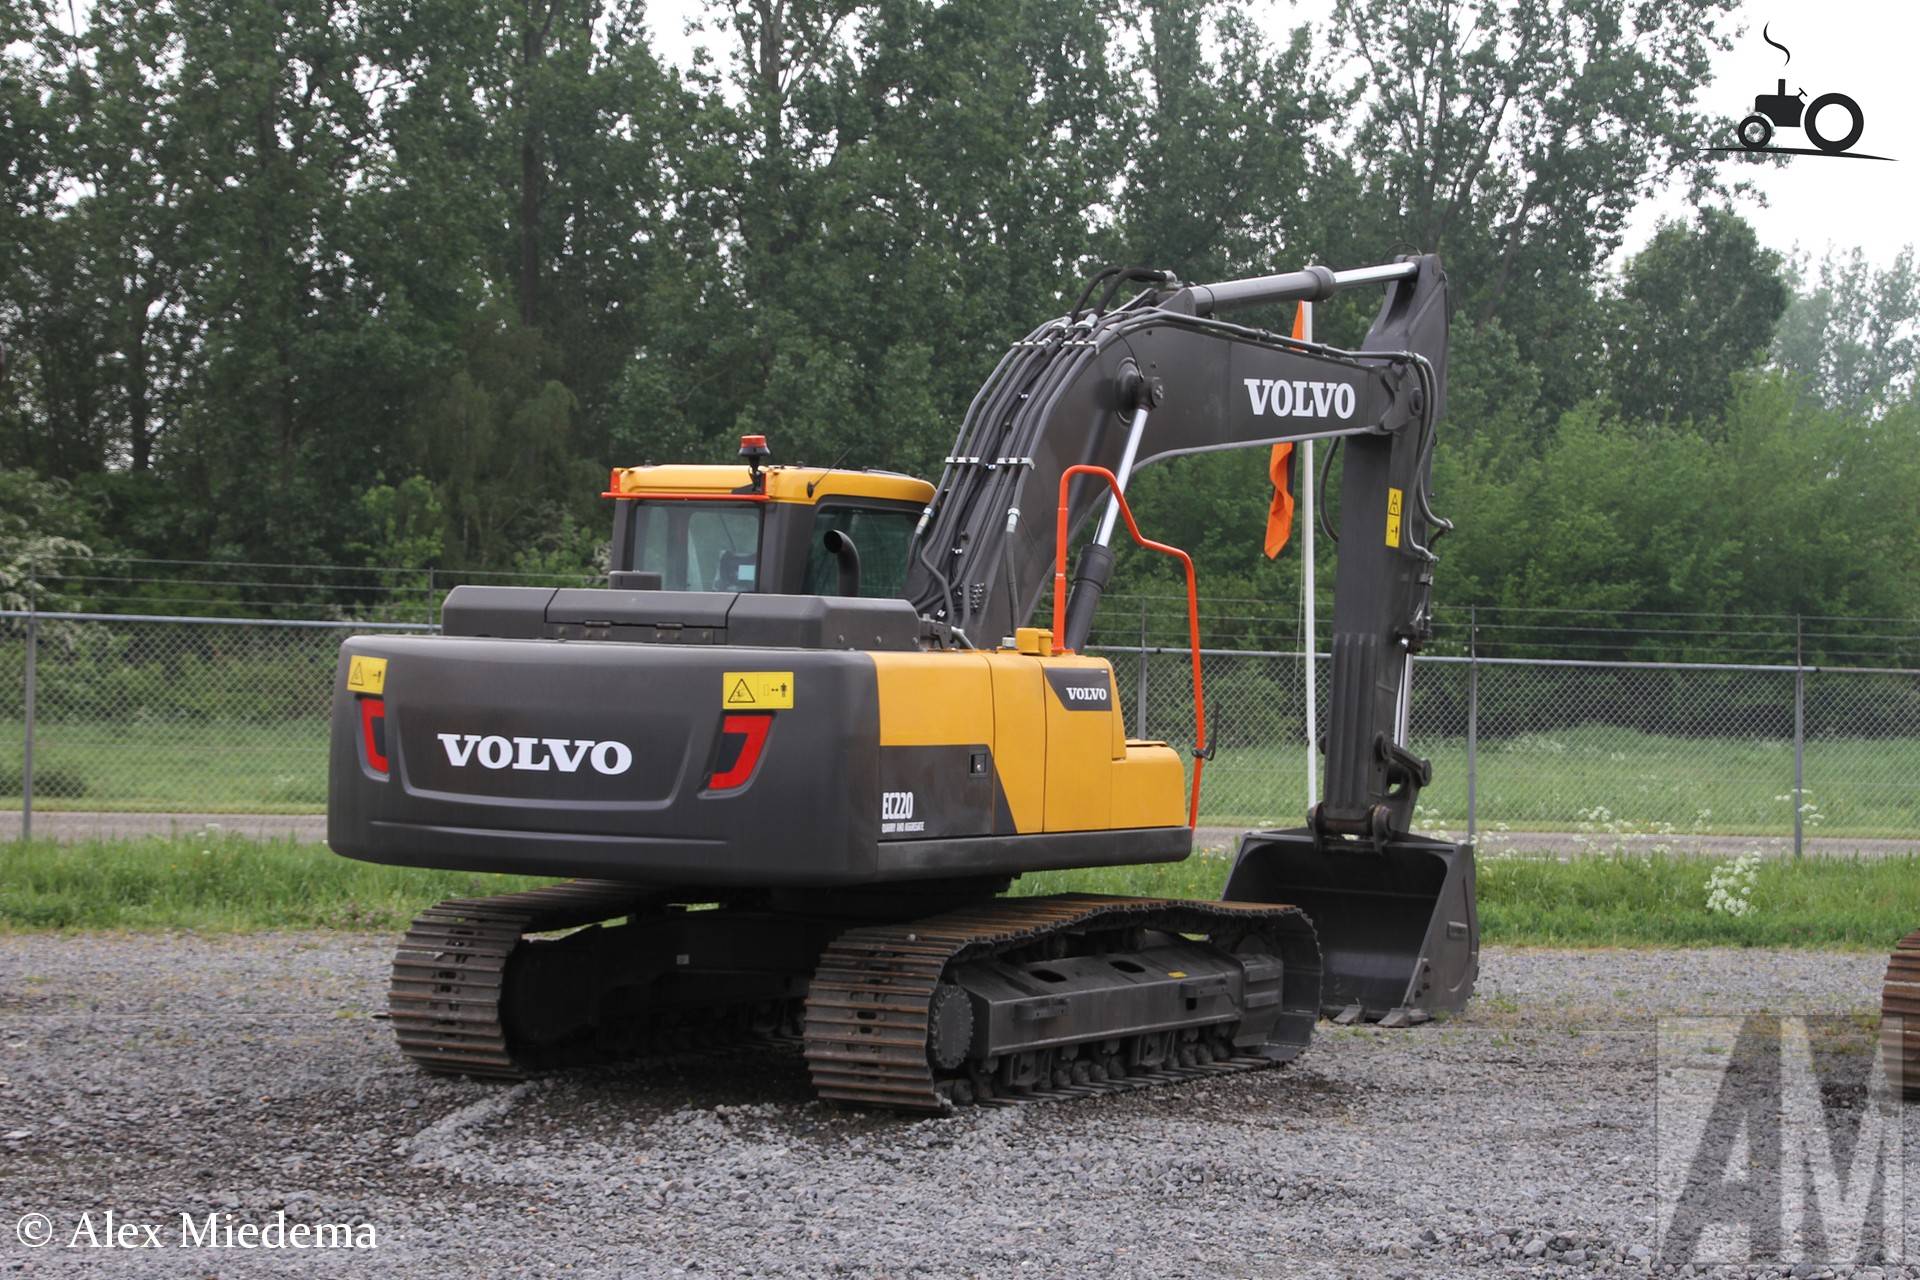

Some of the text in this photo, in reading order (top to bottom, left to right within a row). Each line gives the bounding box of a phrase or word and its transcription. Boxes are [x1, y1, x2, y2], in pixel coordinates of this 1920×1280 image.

[1243, 378, 1356, 420] VOLVO
[1066, 687, 1107, 701] VOLVO
[437, 733, 632, 775] VOLVO
[882, 791, 914, 820] EC220
